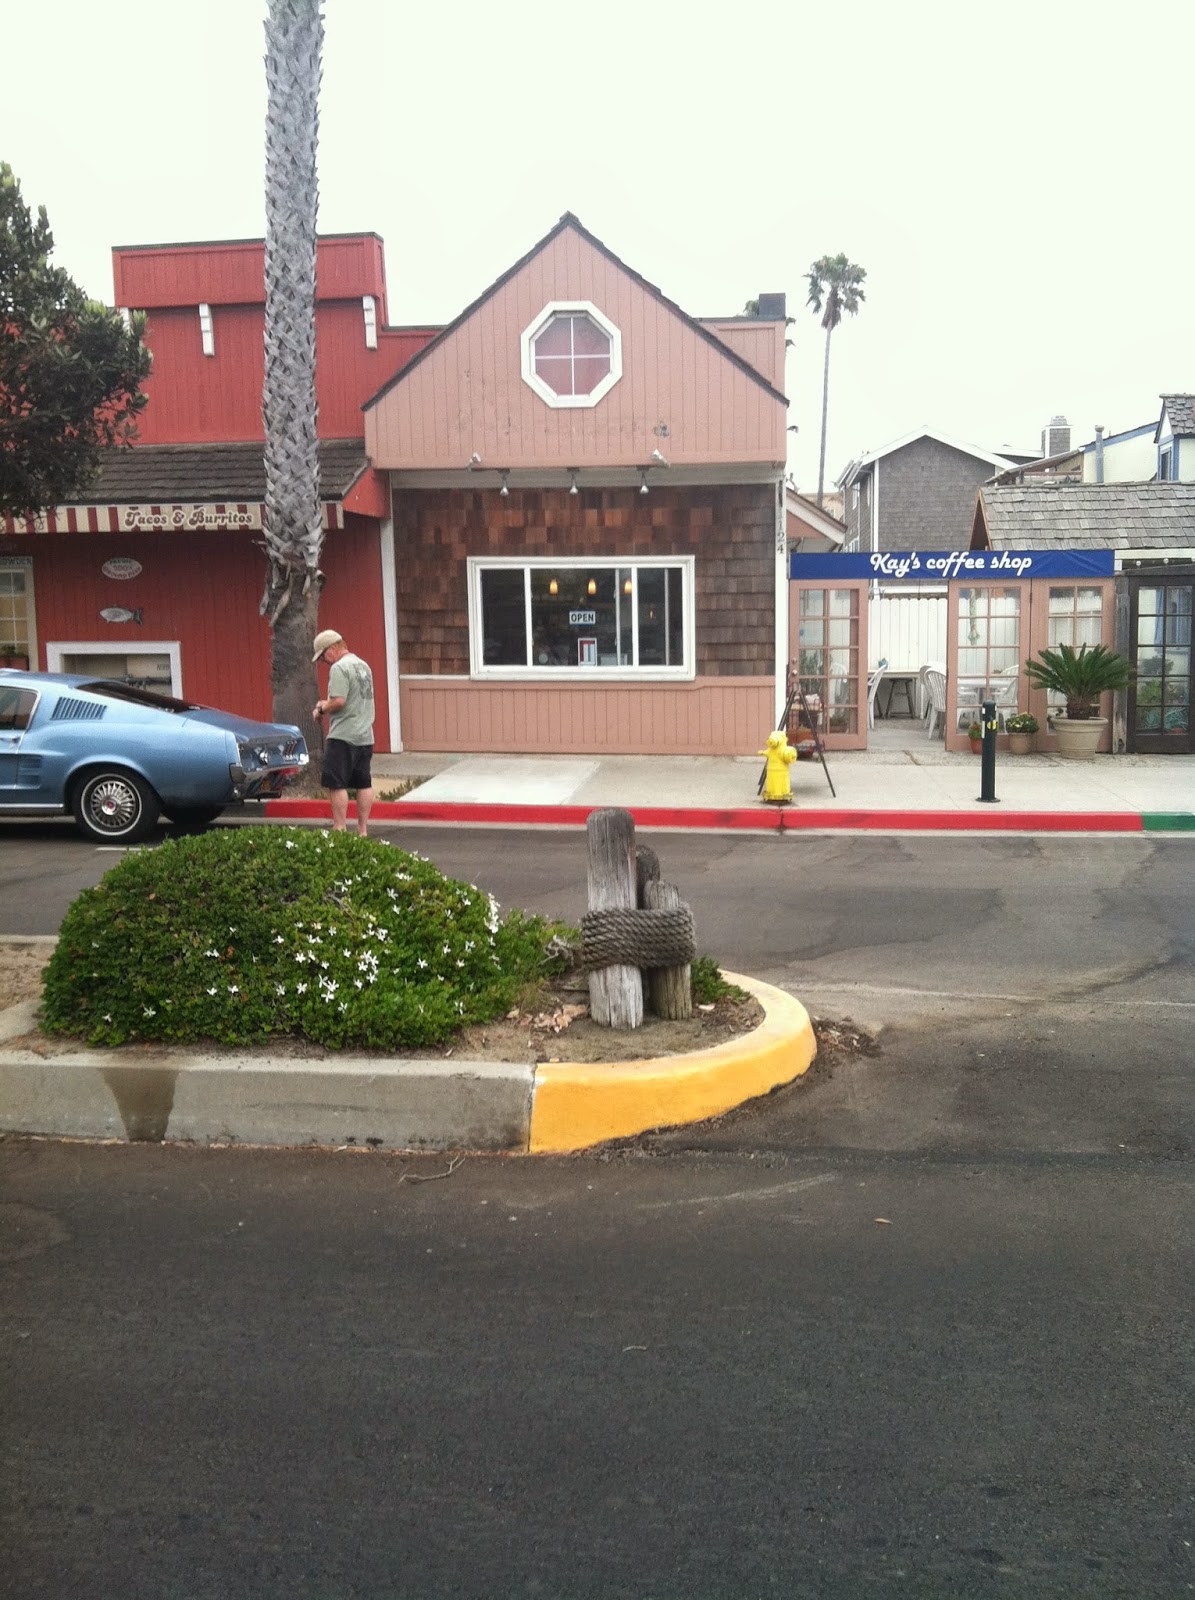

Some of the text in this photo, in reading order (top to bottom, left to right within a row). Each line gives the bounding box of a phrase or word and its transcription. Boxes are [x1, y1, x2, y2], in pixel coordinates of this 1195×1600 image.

[125, 510, 252, 527] Tacos & Burritos
[870, 551, 1032, 578] Kay's coffee shop
[570, 613, 594, 623] OPEN
